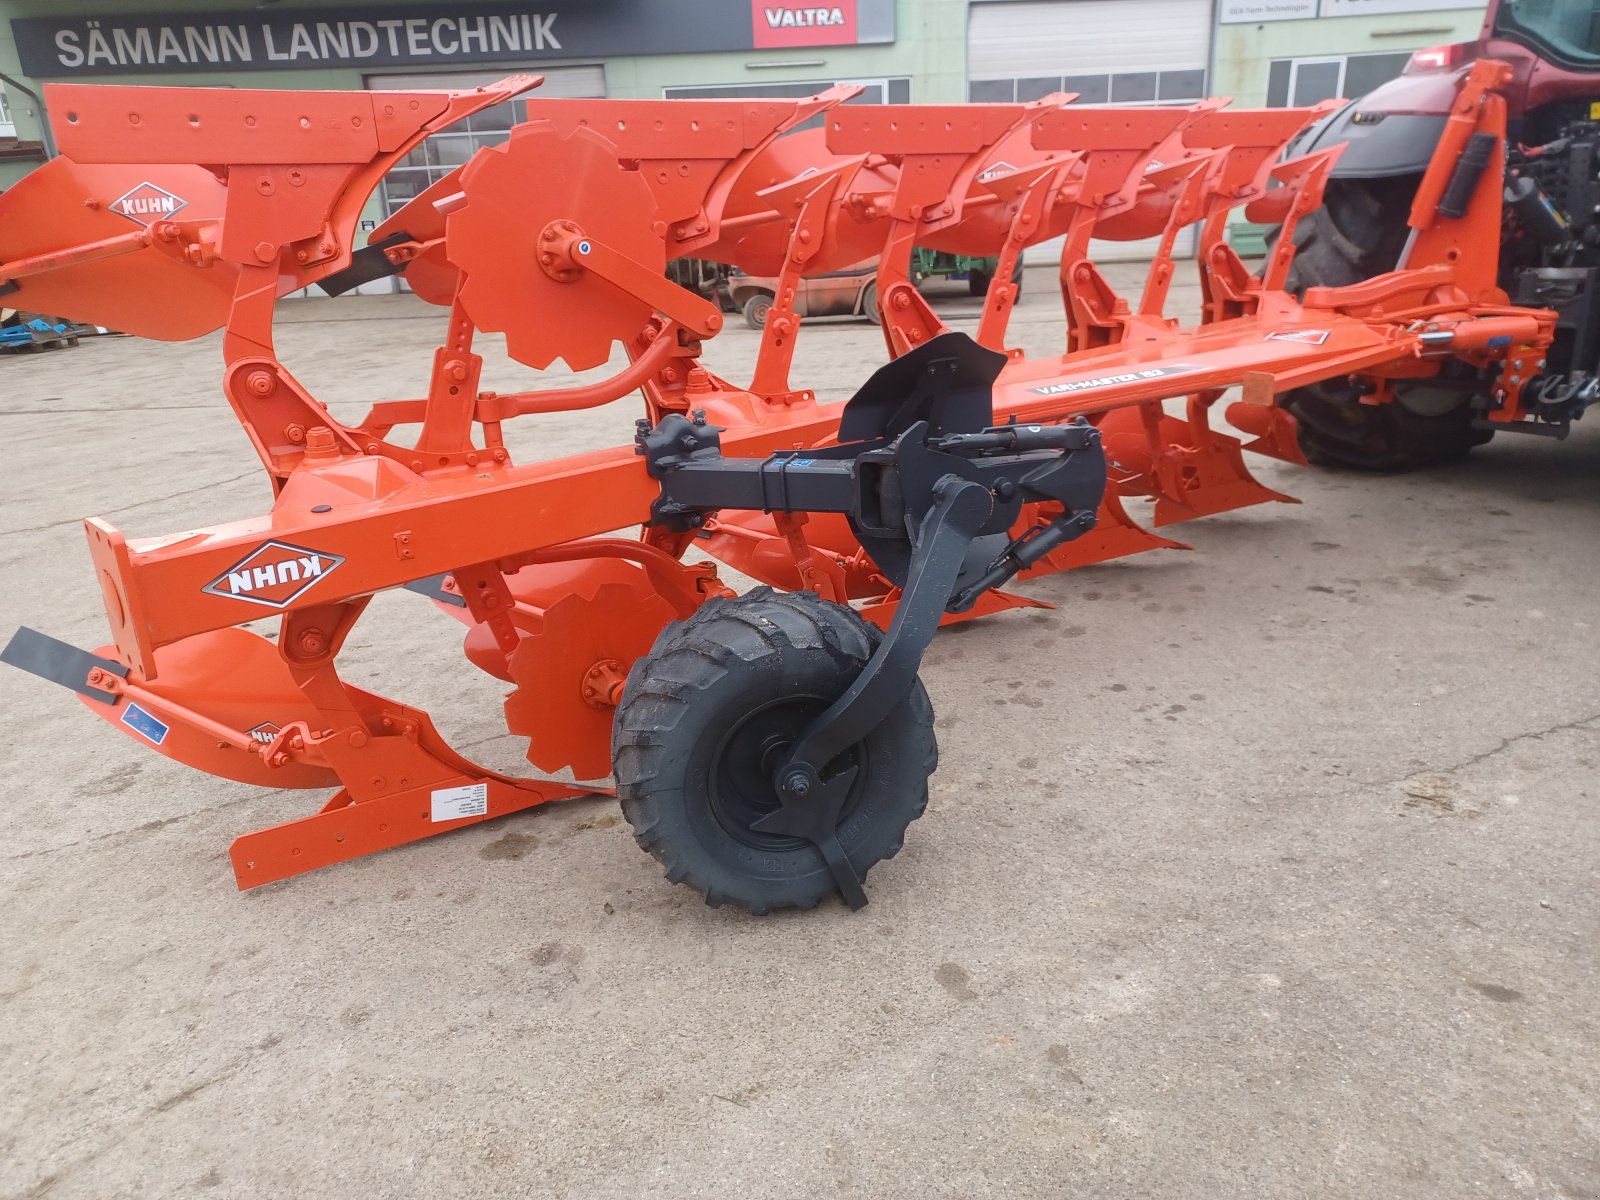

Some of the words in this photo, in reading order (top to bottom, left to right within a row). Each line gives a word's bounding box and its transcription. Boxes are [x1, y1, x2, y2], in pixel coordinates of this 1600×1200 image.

[765, 7, 845, 28] VALTRA
[55, 20, 253, 68] SÄMANN
[266, 12, 563, 61] LANDTECHNIK
[121, 196, 175, 215] KUHN
[1036, 372, 1139, 395] VARI-MASTER
[228, 554, 322, 595] KUHN
